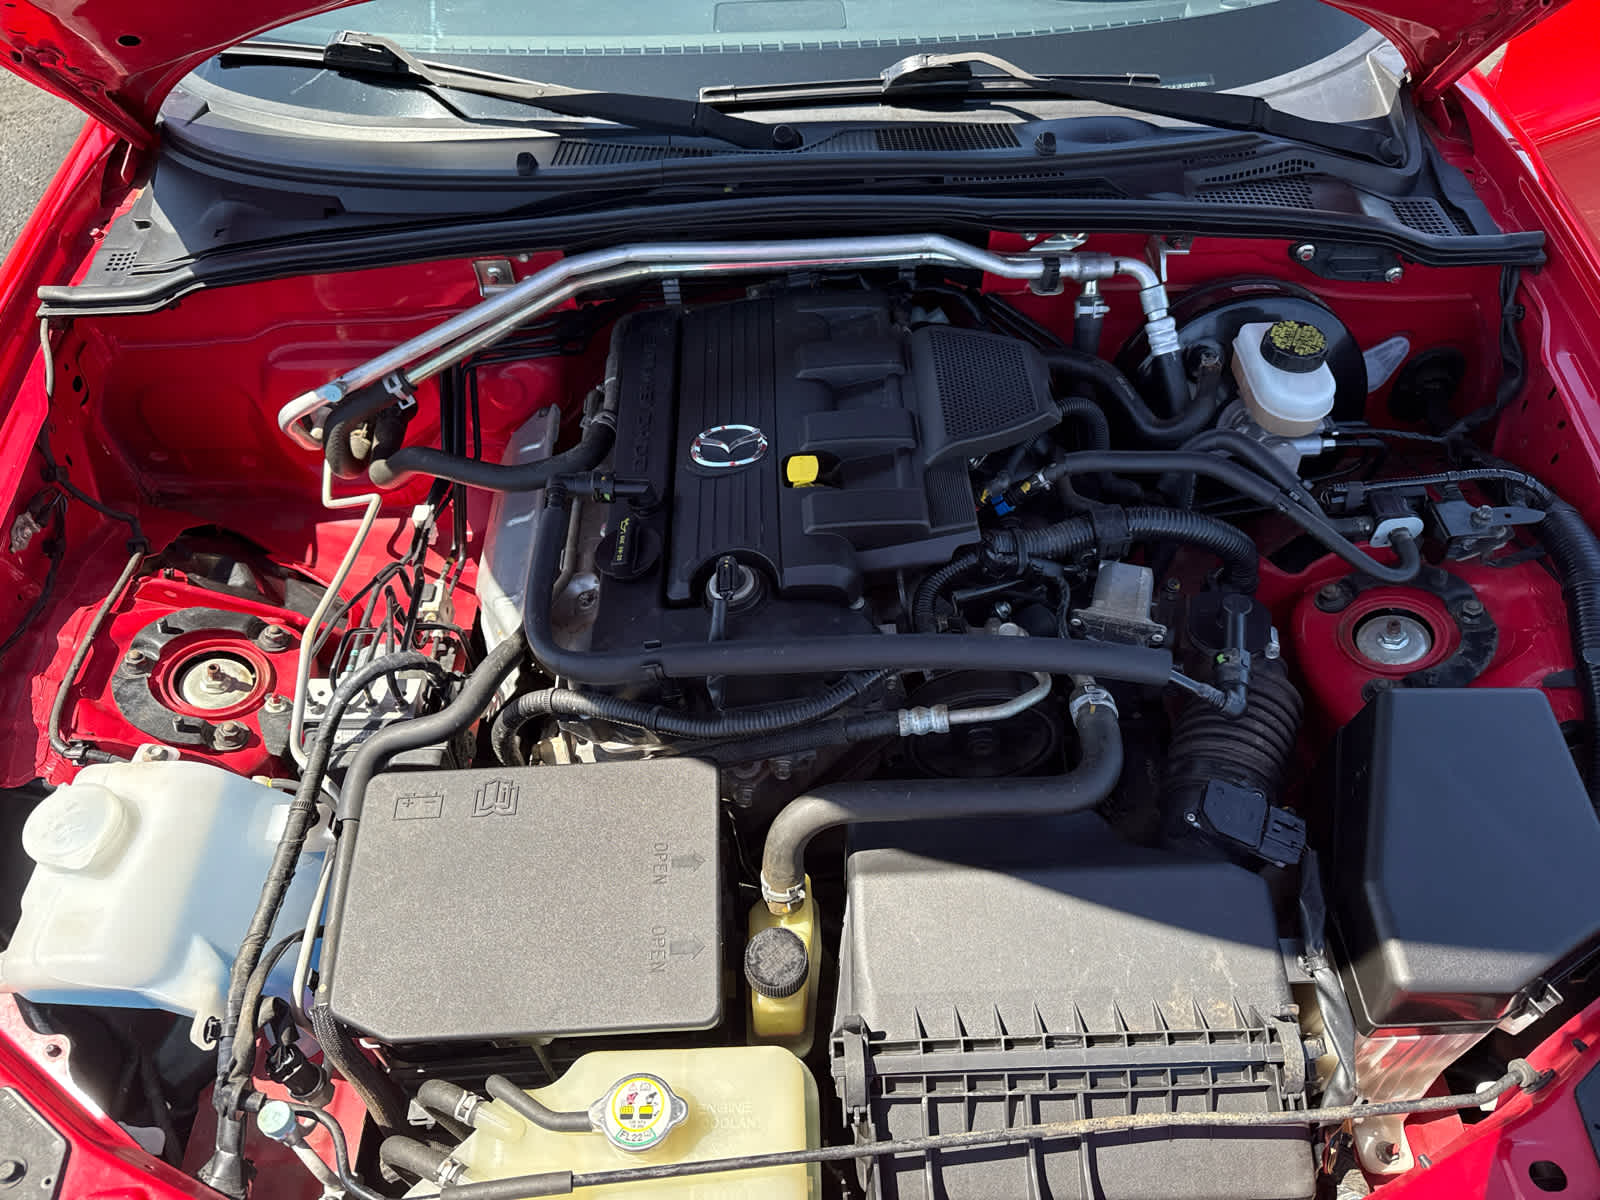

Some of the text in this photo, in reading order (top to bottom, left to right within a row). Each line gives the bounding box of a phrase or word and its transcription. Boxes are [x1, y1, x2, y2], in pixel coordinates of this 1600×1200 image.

[652, 842, 669, 885] OPEN
[648, 926, 668, 973] OPEN
[619, 1130, 643, 1142] FL22
